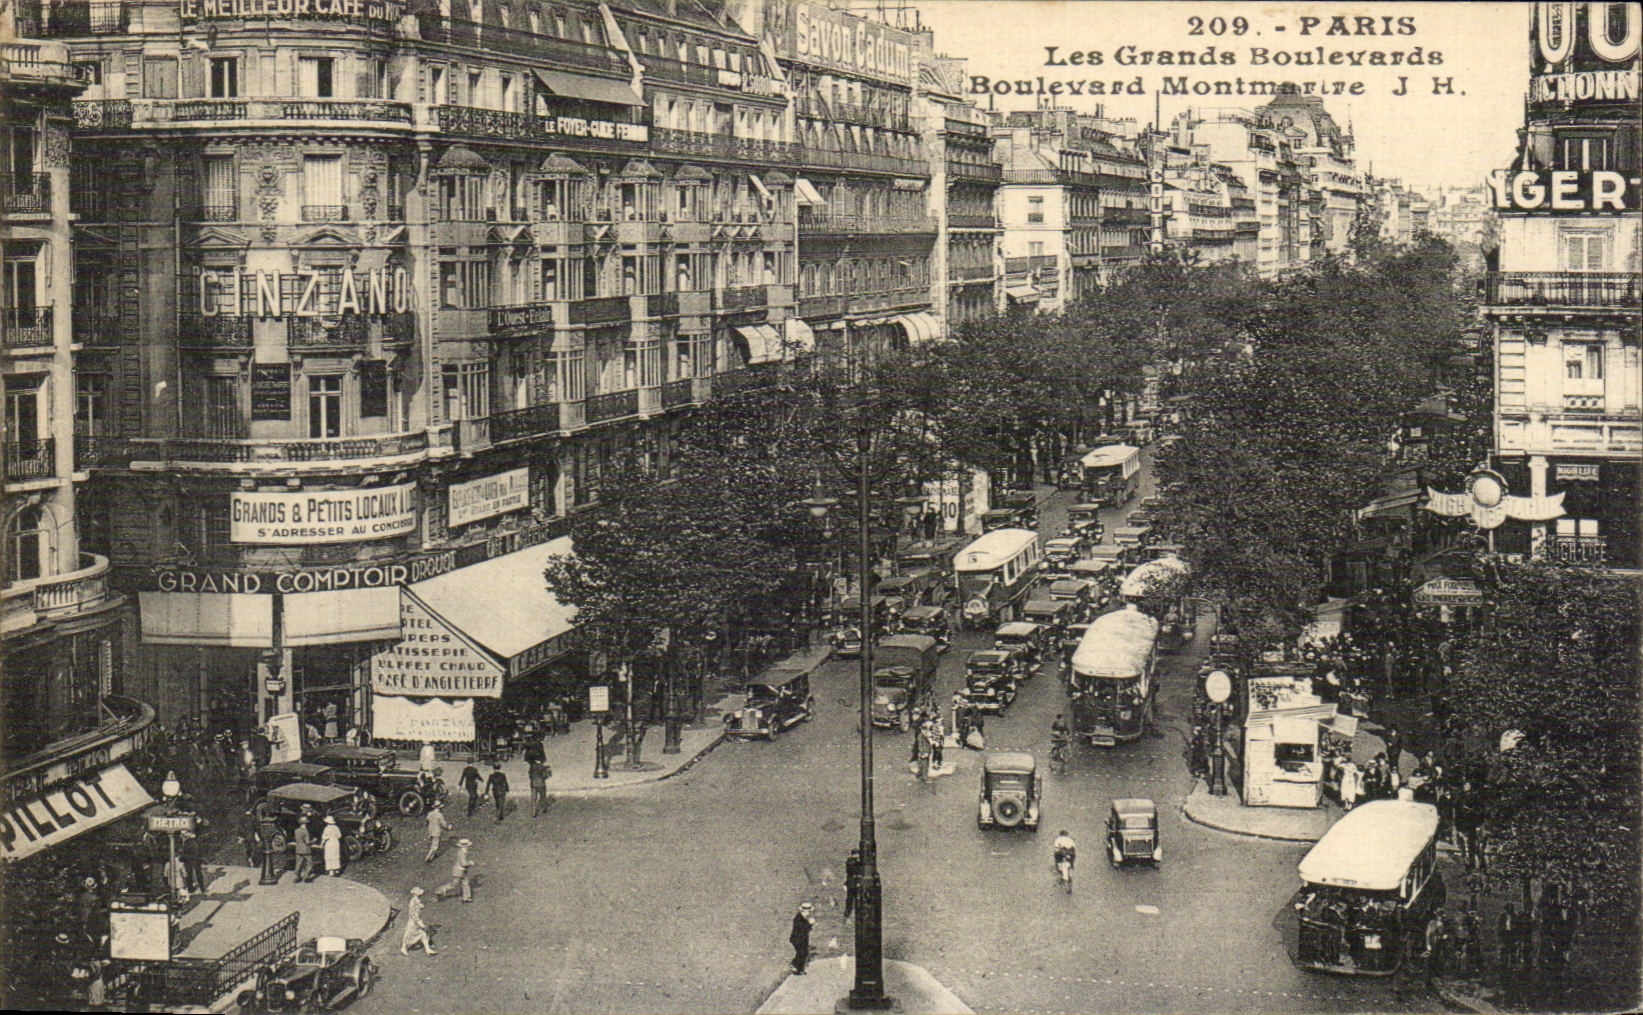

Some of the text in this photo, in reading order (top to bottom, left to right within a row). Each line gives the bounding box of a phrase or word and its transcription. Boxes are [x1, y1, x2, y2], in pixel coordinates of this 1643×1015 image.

[180, 2, 197, 17] LE
[204, 2, 310, 17] MEILLEUR
[796, 3, 909, 81] Savon Cadum
[545, 120, 556, 133] LE
[199, 267, 408, 319] CINZANO
[233, 498, 286, 523] GRANDS
[292, 503, 302, 523] &
[307, 498, 353, 523] PETITS
[356, 490, 397, 520] LOCAUX
[257, 526, 344, 538] S'ADRESSER
[351, 525, 366, 535] AU
[158, 571, 261, 594] GRAND
[276, 565, 408, 594] COMPTOIR
[411, 550, 457, 584] DROUOT
[440, 661, 486, 671] CHAUD
[412, 674, 499, 690] D'ANGLETERRE
[0, 772, 117, 854] PILLOT
